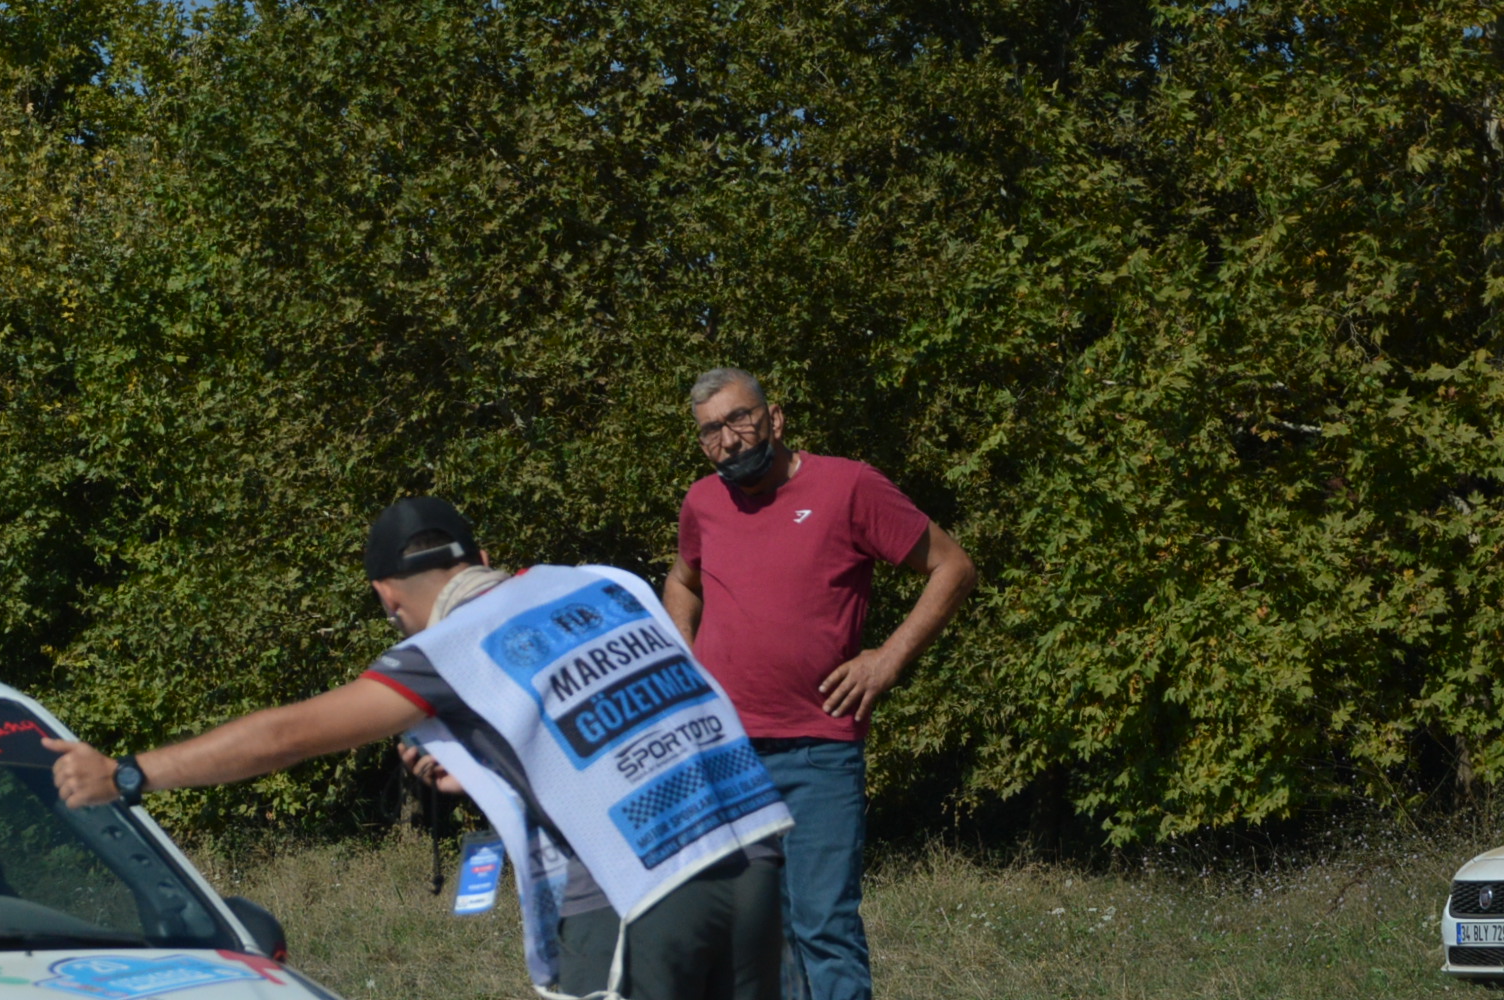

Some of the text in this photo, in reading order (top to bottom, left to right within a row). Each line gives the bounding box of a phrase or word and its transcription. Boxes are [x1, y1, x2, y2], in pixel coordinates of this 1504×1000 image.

[549, 625, 674, 702] MARSHAL
[1473, 924, 1489, 942] BLY
[1492, 924, 1504, 942] 72
